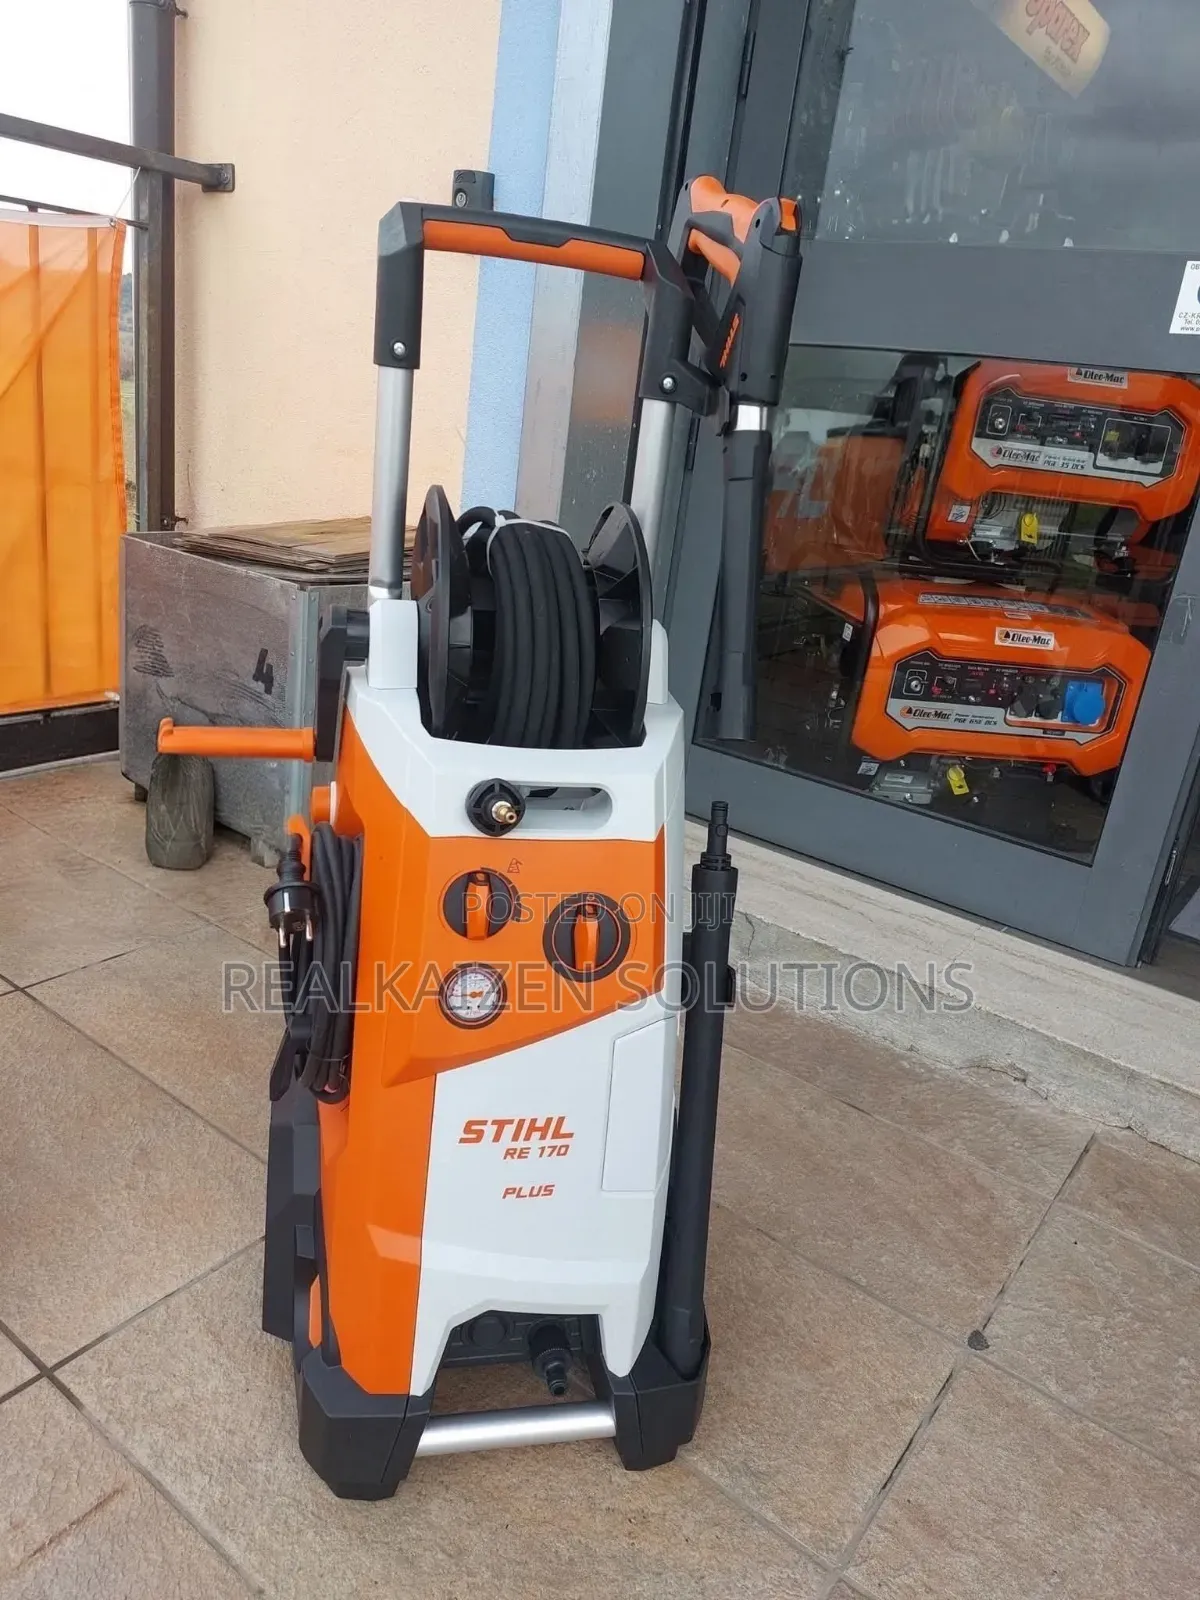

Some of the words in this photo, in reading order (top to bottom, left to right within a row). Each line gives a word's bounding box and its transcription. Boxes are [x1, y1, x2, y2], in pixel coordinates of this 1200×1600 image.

[252, 647, 274, 695] 4
[458, 1116, 575, 1144] STIHL
[503, 1147, 531, 1160] RE
[538, 1144, 570, 1158] 170
[502, 1184, 555, 1199] PLUS
